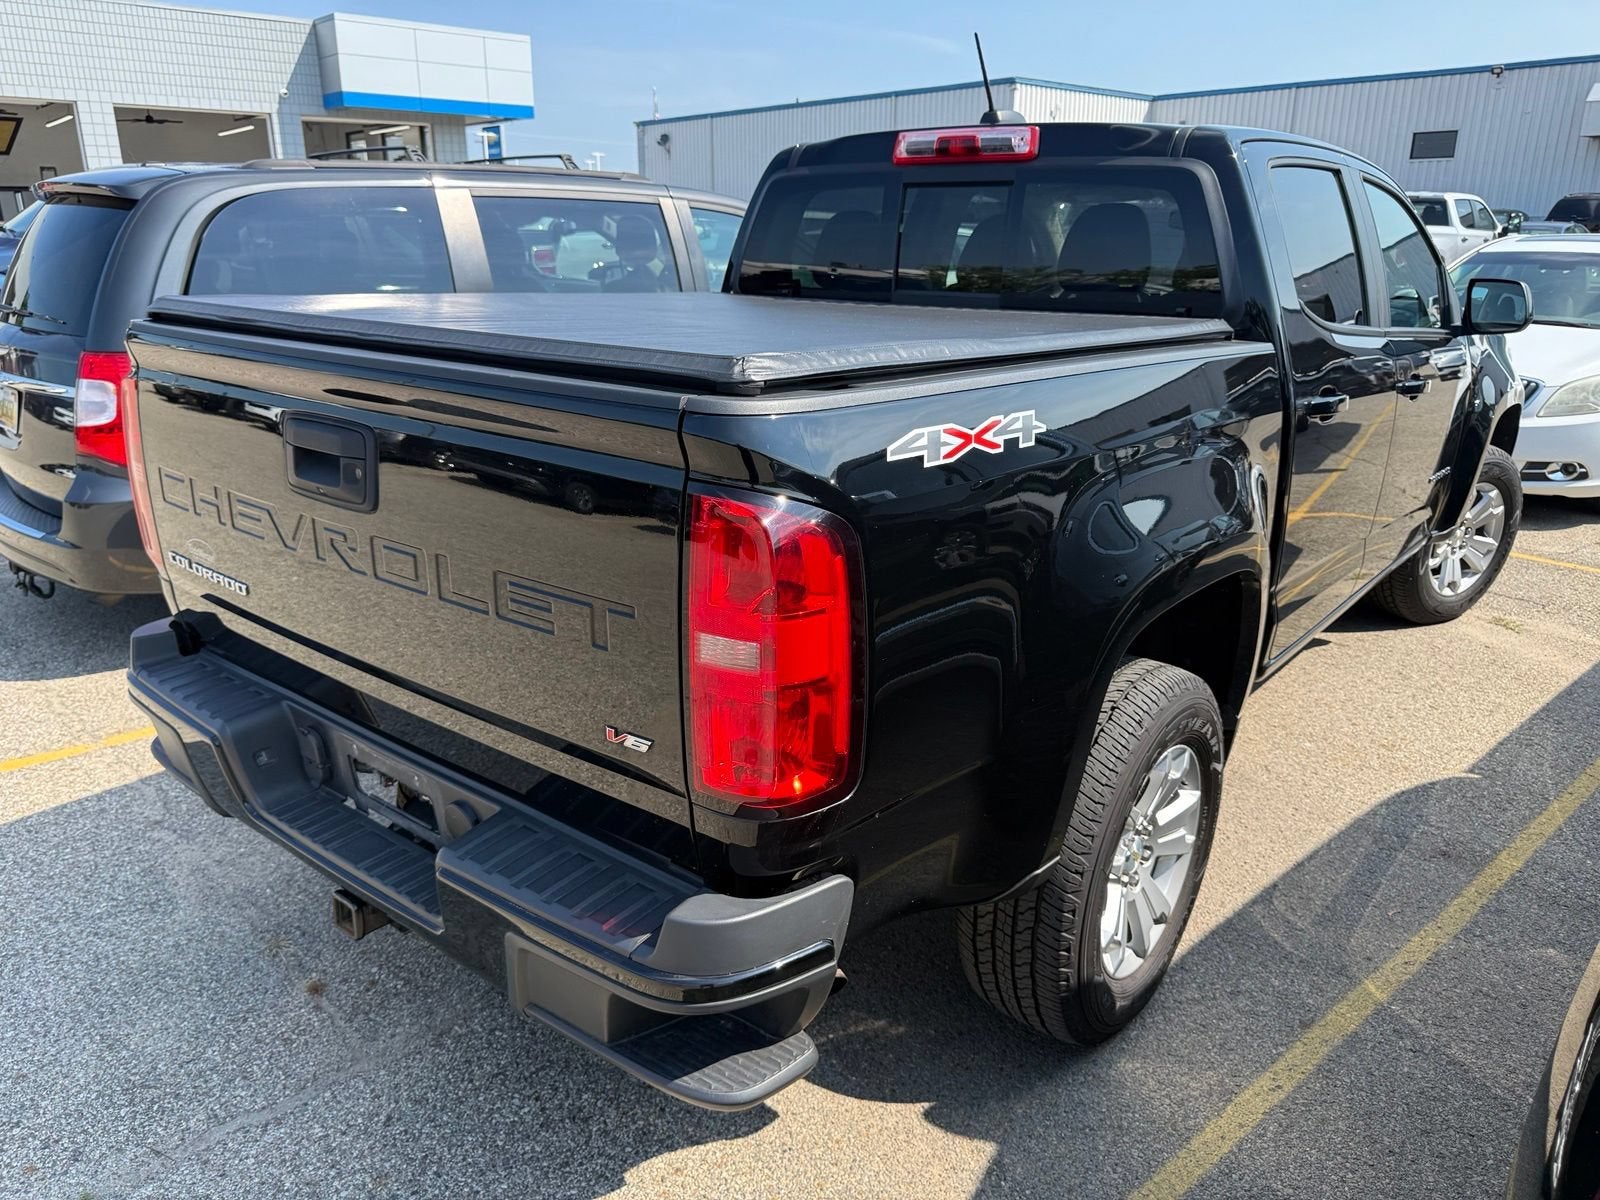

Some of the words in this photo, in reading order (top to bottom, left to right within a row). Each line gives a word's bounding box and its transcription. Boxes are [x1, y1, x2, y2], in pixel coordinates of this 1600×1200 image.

[159, 466, 637, 652] CHEVROLET
[168, 550, 249, 596] COLORADO
[605, 725, 653, 753] V6
